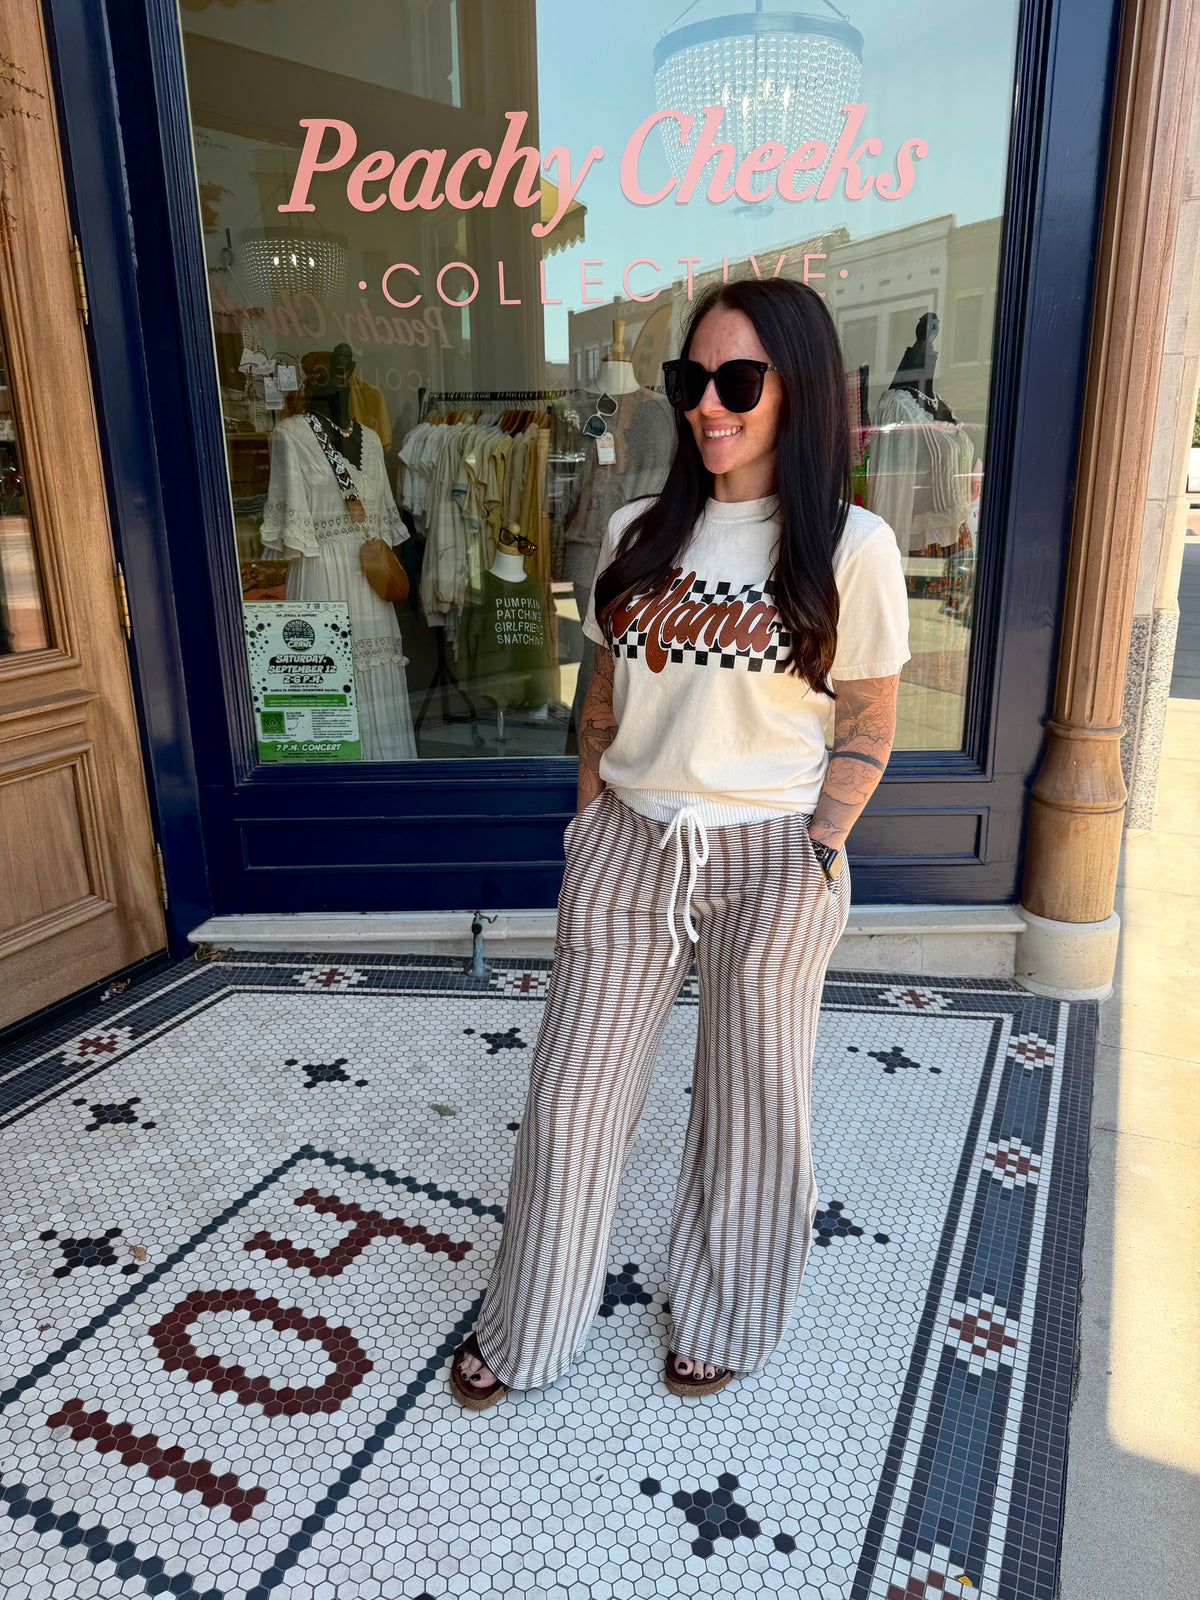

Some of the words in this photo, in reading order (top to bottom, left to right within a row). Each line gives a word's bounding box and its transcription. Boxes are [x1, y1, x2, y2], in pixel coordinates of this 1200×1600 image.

[278, 111, 604, 238] Peachy
[619, 104, 929, 208] Cheeks
[495, 597, 541, 609] PUMPKIN
[610, 566, 779, 674] Mama
[494, 621, 543, 635] GIRLFRIE
[268, 664, 324, 674] SEPTEMBER
[325, 664, 337, 674] 12
[276, 744, 282, 752] 7
[282, 744, 300, 752] P.M.
[301, 743, 342, 752] CONCERT
[46, 1187, 473, 1522] 104
